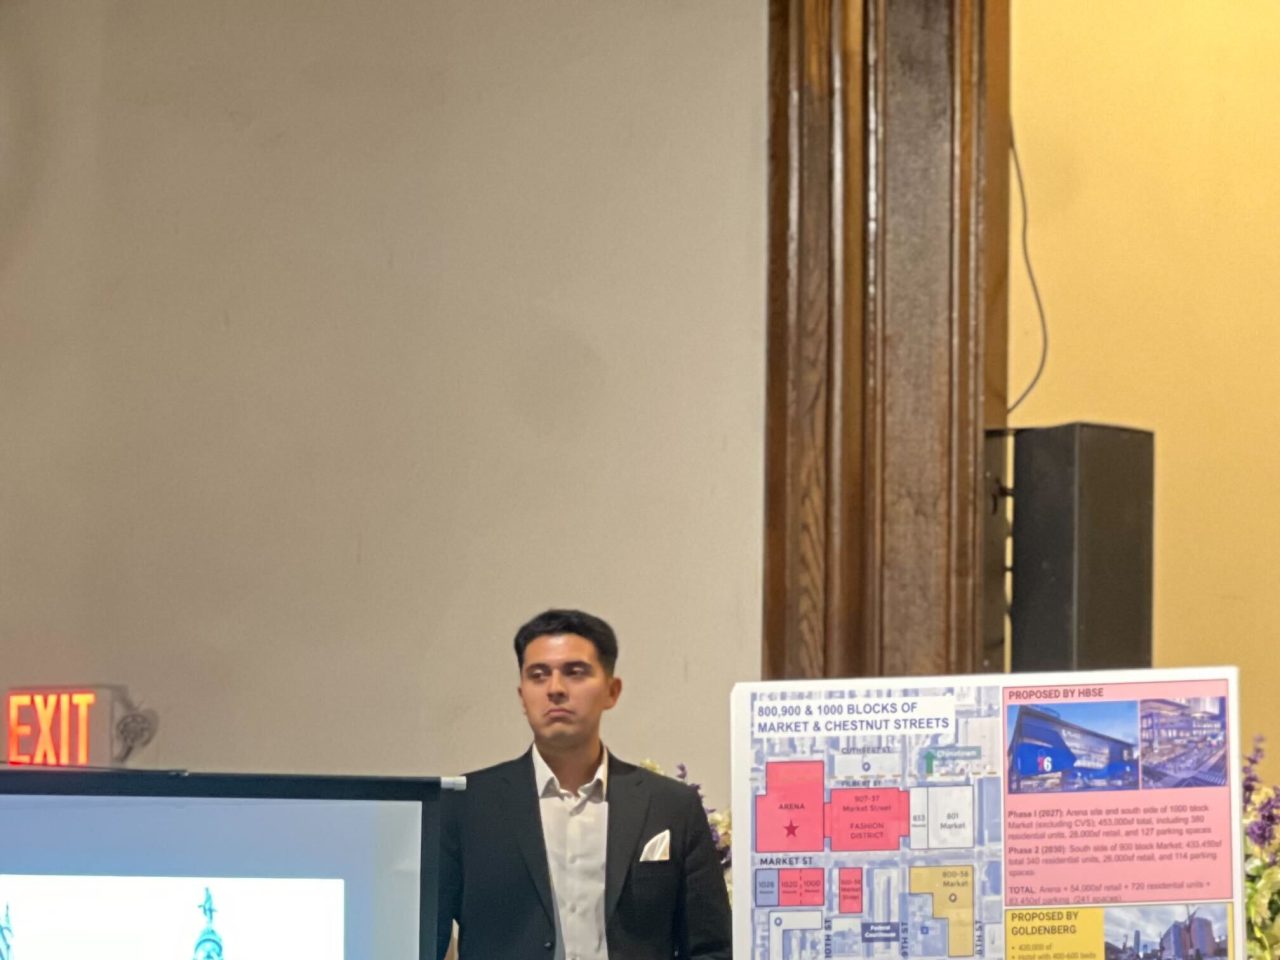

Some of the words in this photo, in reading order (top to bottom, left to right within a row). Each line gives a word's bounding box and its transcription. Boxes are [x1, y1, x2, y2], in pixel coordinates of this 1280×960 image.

[1009, 688, 1060, 700] PROPOSED
[1062, 688, 1075, 699] BY
[1078, 687, 1104, 698] HBSE
[757, 705, 800, 719] 800,900
[804, 704, 814, 716] &
[817, 703, 843, 716] 1000
[847, 702, 897, 715] BLOCKS
[901, 701, 918, 713] OF
[8, 692, 96, 767] EXIT
[757, 720, 809, 734] MARKET
[812, 720, 821, 731] &
[824, 719, 889, 732] CHESTNUT
[894, 717, 949, 730] STREETS
[778, 802, 805, 811] ARENA
[842, 804, 868, 813] Market
[869, 803, 892, 813] Street
[850, 822, 884, 831] FASHION
[940, 821, 967, 831] Market
[850, 831, 884, 840] DISTRICT
[760, 856, 799, 866] MARKET
[801, 856, 813, 866] ST
[1011, 911, 1064, 922] PROPOSED
[1066, 910, 1079, 921] BY
[1011, 924, 1077, 936] GOLDENBERG
